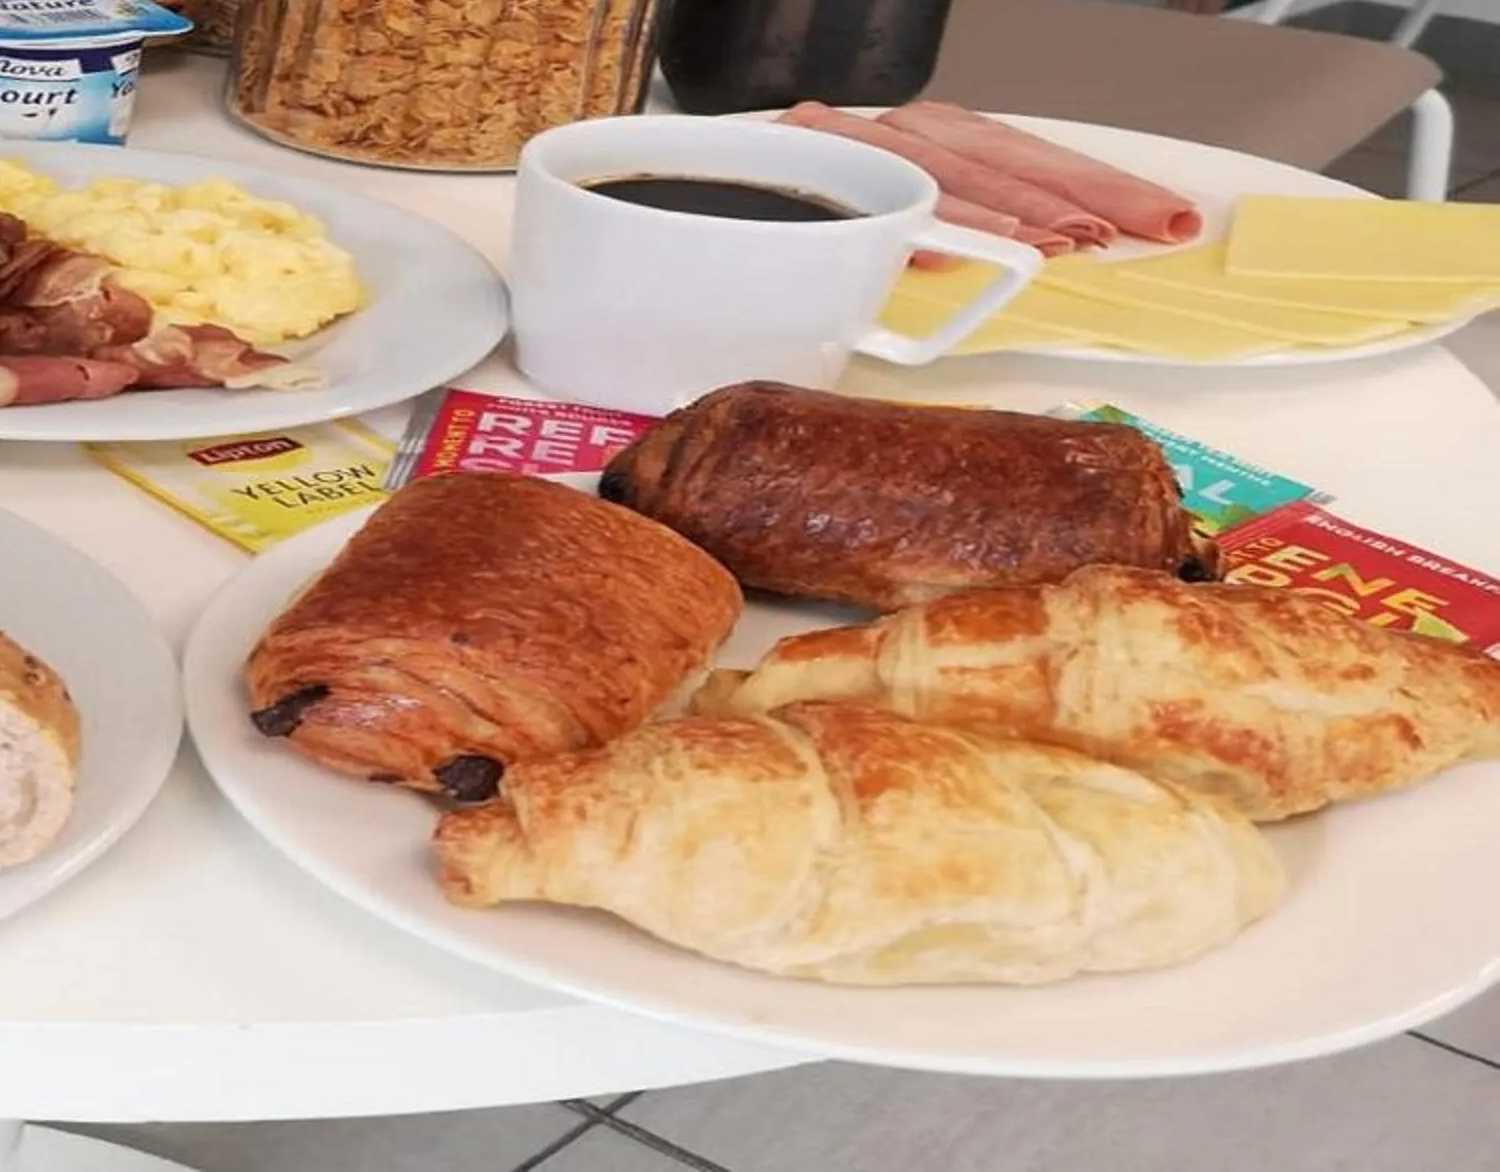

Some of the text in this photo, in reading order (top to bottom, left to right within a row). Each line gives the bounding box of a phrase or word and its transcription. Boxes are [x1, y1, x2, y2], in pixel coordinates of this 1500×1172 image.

[476, 411, 637, 447] REF
[200, 439, 294, 464] Lipton
[466, 436, 578, 467] RE
[229, 463, 377, 502] YELLOW
[272, 479, 386, 510] LABEL
[1304, 513, 1405, 558] ENGLISH
